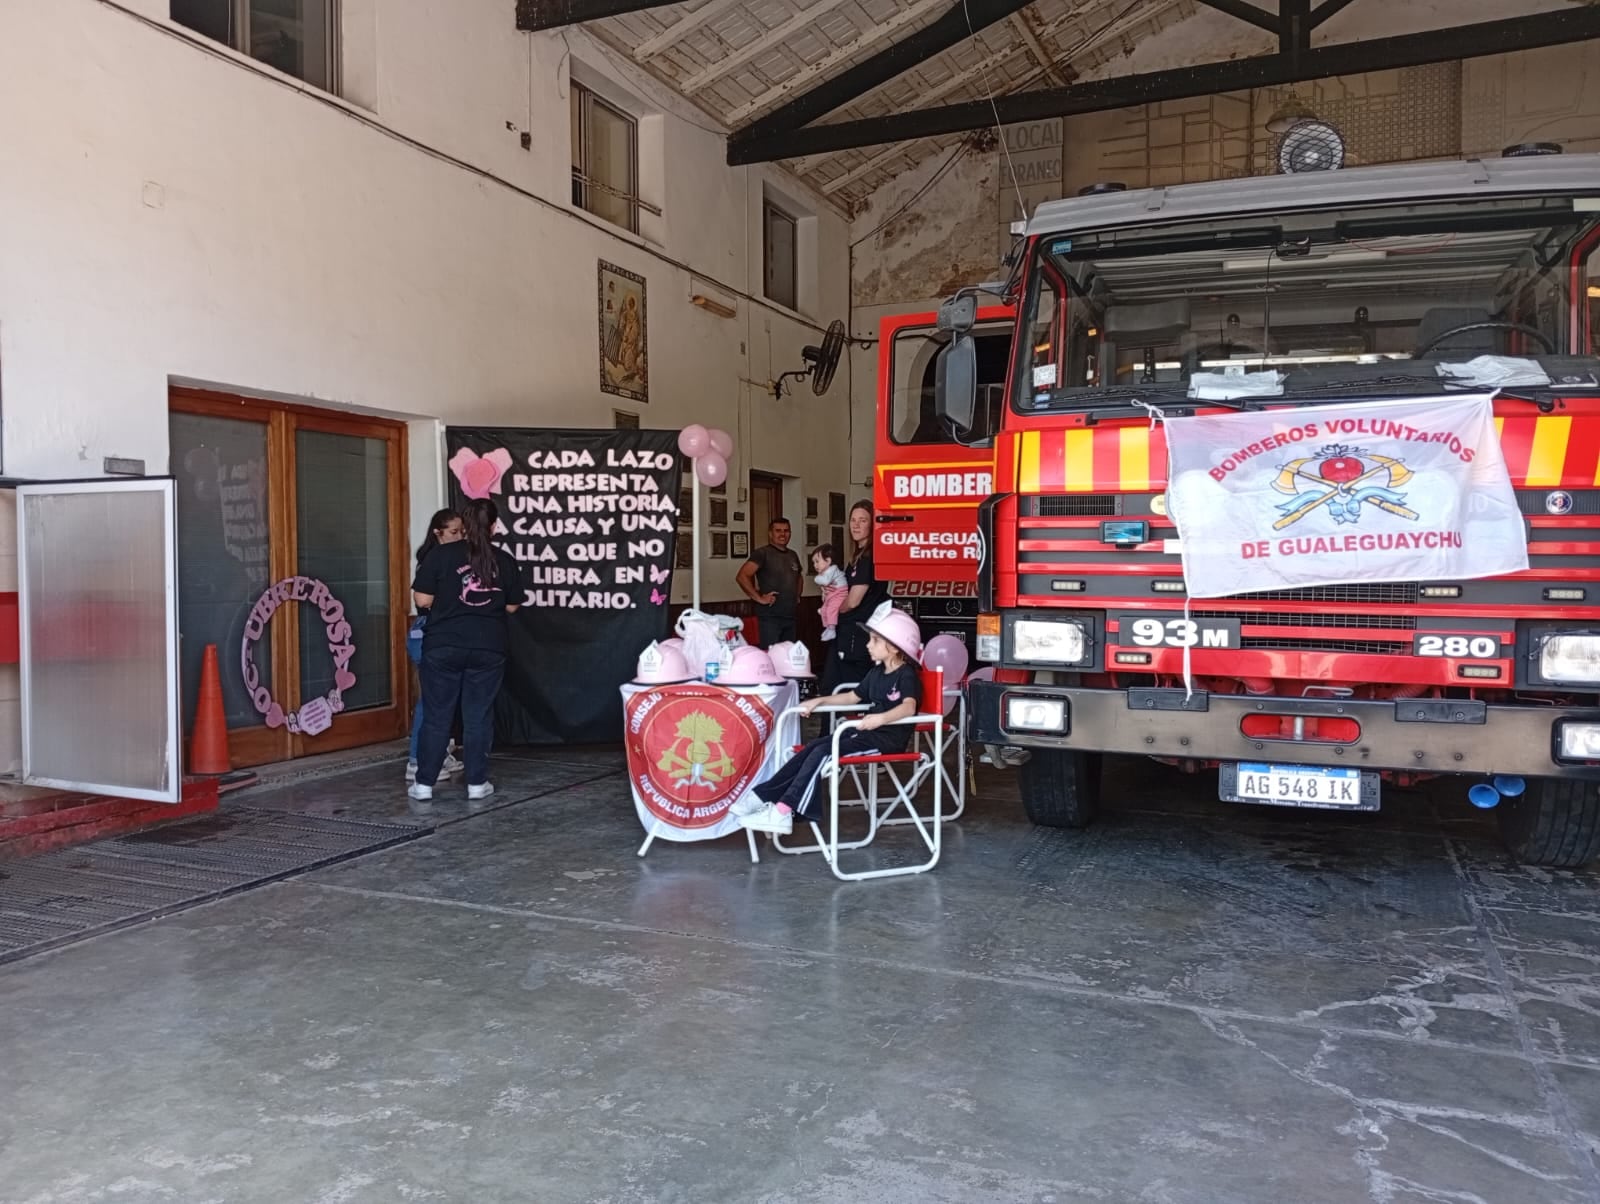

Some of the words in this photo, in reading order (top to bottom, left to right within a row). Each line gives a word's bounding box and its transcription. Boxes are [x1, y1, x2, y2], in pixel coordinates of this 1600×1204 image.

[1005, 121, 1063, 150] LOCAL
[528, 449, 595, 469] CADA
[607, 449, 674, 471] LAZO
[1208, 423, 1319, 482] BOMBEROS
[1324, 418, 1476, 463] VOLUNTARIOS
[513, 473, 659, 493] REPRESENTA
[508, 495, 562, 513] UNA
[568, 494, 681, 517] HISTORIA,
[513, 517, 594, 537] CAUSA
[597, 517, 615, 536] Y
[621, 513, 674, 533] UNA
[567, 543, 617, 561] QUE
[628, 539, 665, 559] NO
[909, 547, 958, 559] Entre
[1241, 541, 1271, 560] DE
[1278, 531, 1463, 556] GUALEGUAYCHU
[533, 566, 602, 586] LIBRA
[615, 566, 645, 583] EN
[1418, 636, 1496, 658] 280
[630, 691, 664, 735] CONSEJO
[692, 774, 749, 819] ARGENTINA
[1244, 775, 1270, 795] AG
[1278, 776, 1319, 799] 548
[1327, 779, 1353, 801] IK
